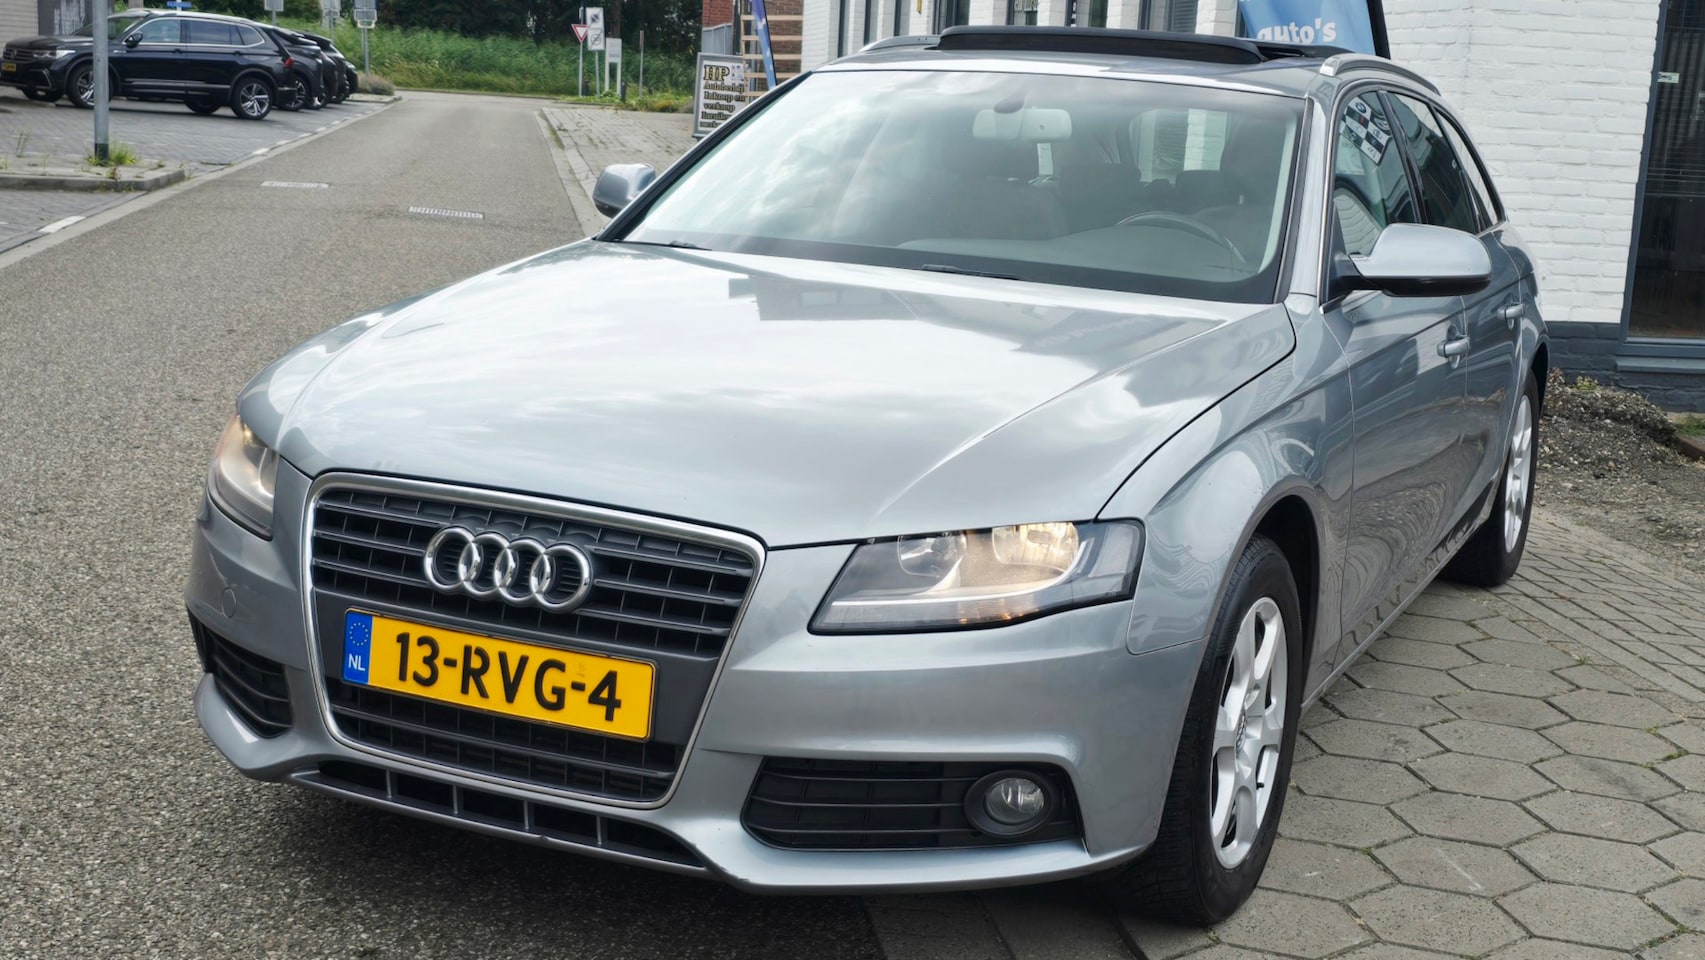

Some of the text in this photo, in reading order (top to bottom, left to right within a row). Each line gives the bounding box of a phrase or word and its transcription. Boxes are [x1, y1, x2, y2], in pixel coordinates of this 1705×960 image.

[1257, 18, 1337, 45] auto's
[703, 65, 730, 81] HP
[347, 653, 366, 672] NL
[396, 632, 622, 722] 13-RVG-4
